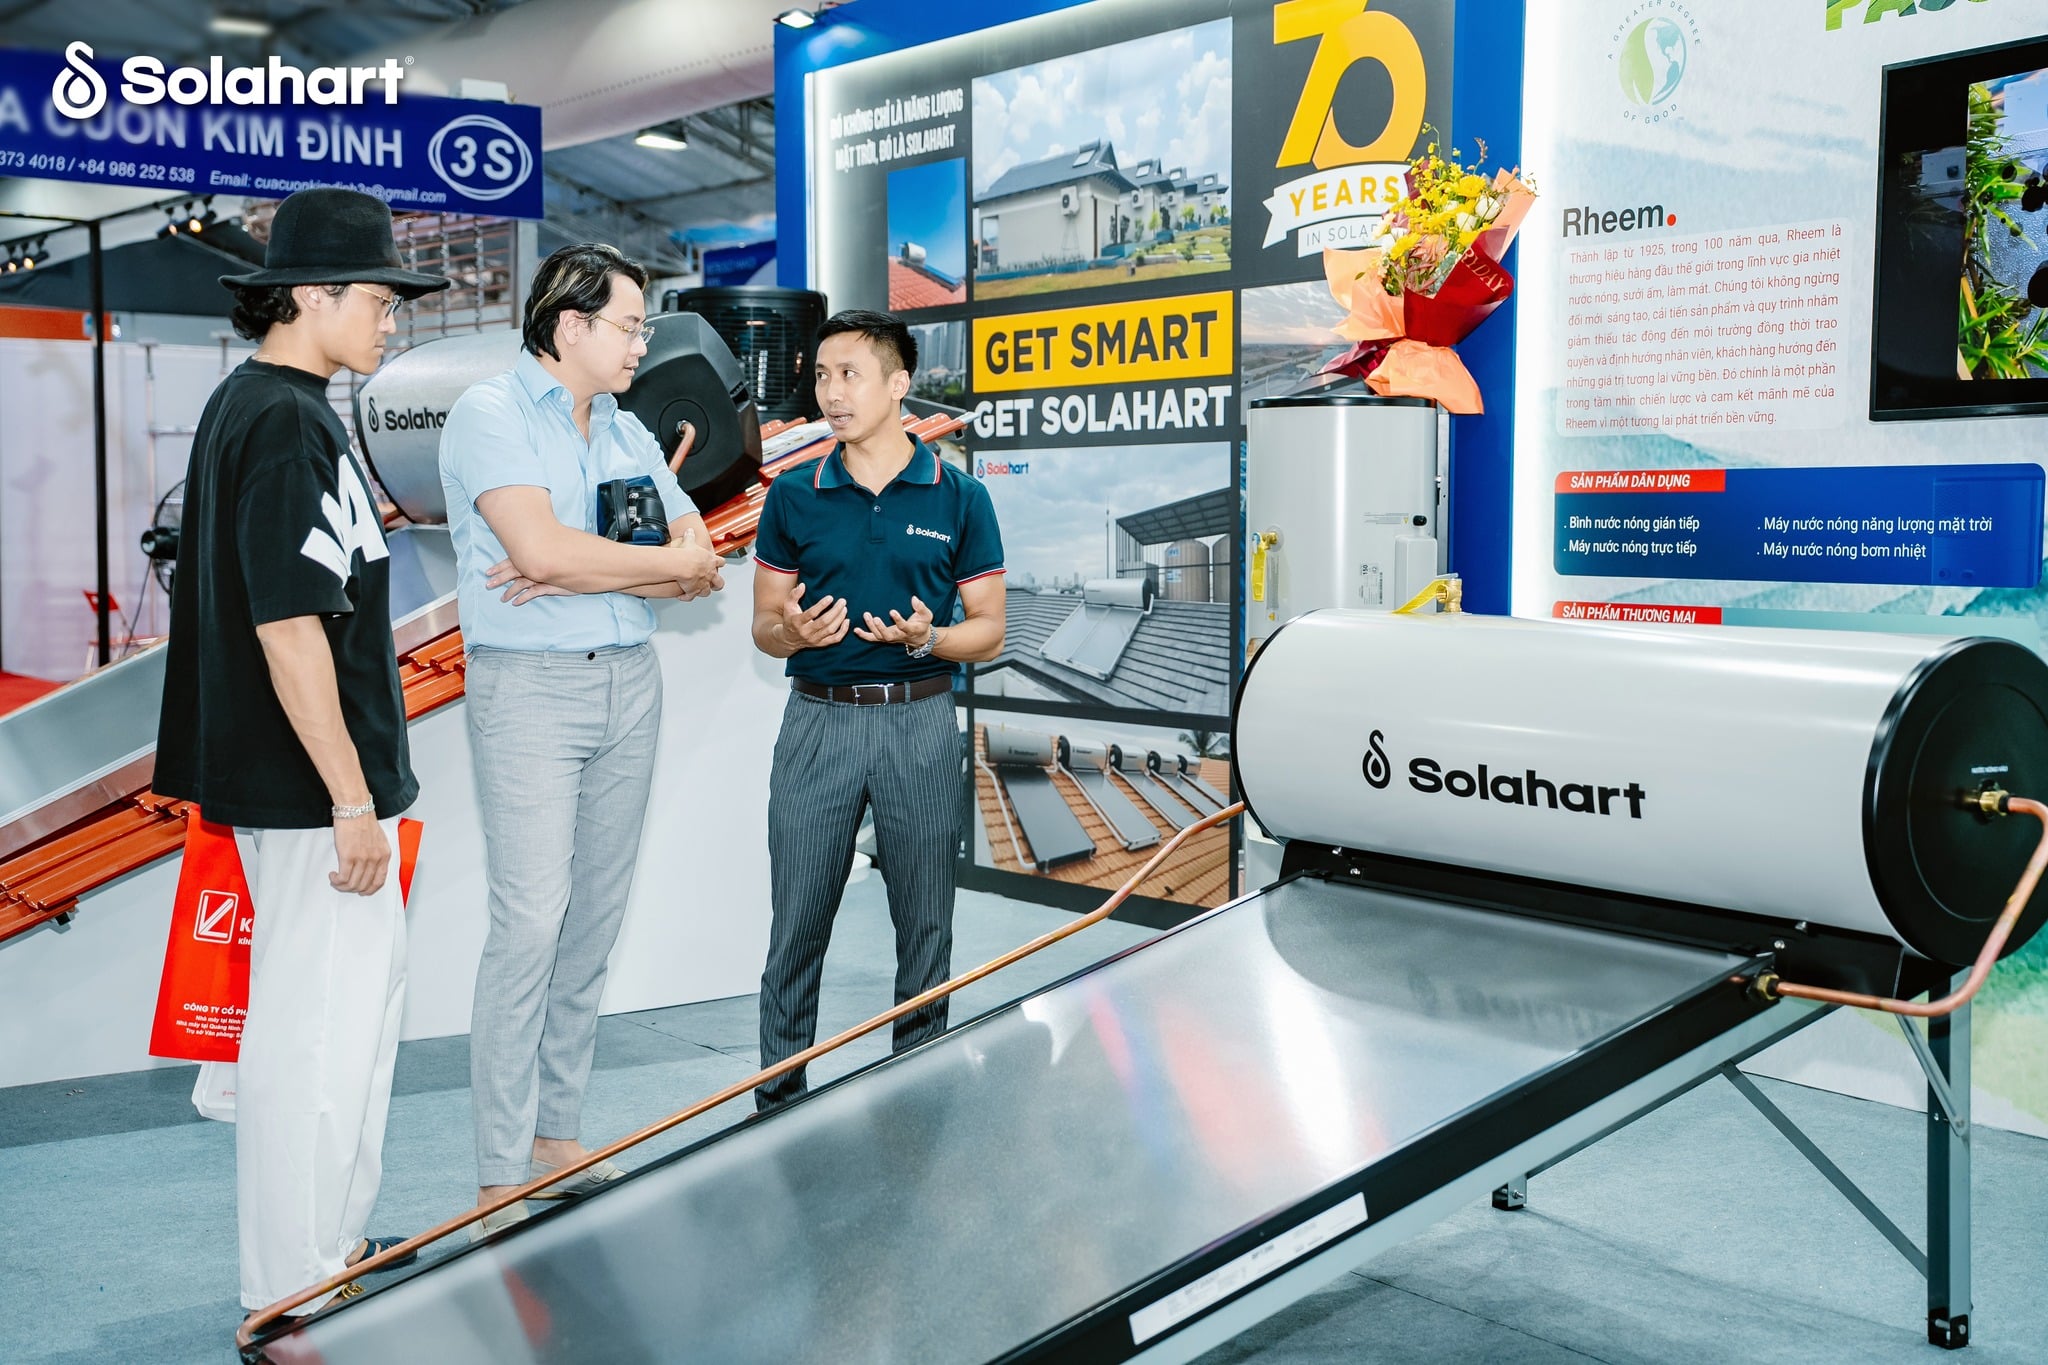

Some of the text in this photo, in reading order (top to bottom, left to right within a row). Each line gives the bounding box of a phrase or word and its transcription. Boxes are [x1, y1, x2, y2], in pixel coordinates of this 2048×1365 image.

[1274, 0, 1427, 170] 70
[1645, 104, 1677, 124] GOOD
[202, 112, 284, 158] KIM
[906, 124, 956, 156] SOLAHART
[29, 154, 66, 172] 4018
[78, 159, 104, 175] +84
[108, 161, 136, 178] 986
[139, 164, 165, 180] 252
[168, 166, 195, 183] 538
[210, 170, 251, 188] Email:
[1289, 176, 1400, 216] YEARS
[1307, 231, 1320, 246] IN
[1640, 244, 1666, 256] 1925,
[1672, 242, 1697, 253] trong
[1704, 237, 1722, 250] 100
[1758, 233, 1780, 246] qua,
[1788, 228, 1824, 240] Rheem
[1832, 224, 1841, 236] là
[1628, 267, 1651, 280] hàng
[1717, 260, 1744, 272] trong
[1770, 255, 1789, 267] vực
[1793, 251, 1808, 266] gia
[1813, 248, 1840, 262] nhiệt
[1667, 285, 1685, 296] làm
[1714, 280, 1747, 293] Chúng
[1751, 276, 1764, 289] tôi
[1768, 275, 1800, 288] không
[1804, 272, 1839, 287] ngừng
[1608, 311, 1630, 324] sáng
[1744, 300, 1754, 312] và
[1758, 300, 1776, 314] quy
[1780, 296, 1803, 309] trình
[985, 310, 1218, 375] GET SMART
[1622, 332, 1636, 343] tác
[1694, 326, 1712, 337] môi
[1718, 324, 1752, 337] trường
[1758, 320, 1784, 334] đồng
[1790, 318, 1810, 331] thời
[1816, 319, 1838, 330] trao
[1596, 354, 1606, 365] và
[1610, 352, 1629, 366] định
[1664, 349, 1688, 360] nhân
[1716, 346, 1746, 357] khách
[1750, 344, 1775, 357] hàng
[1778, 342, 1812, 355] hướng
[1816, 338, 1836, 352] đến
[1598, 376, 1612, 389] giá
[1627, 374, 1654, 386] tương
[1658, 372, 1668, 383] lai
[1723, 368, 1736, 379] Đó
[1740, 366, 1768, 378] chính
[1772, 365, 1780, 376] là
[1784, 364, 1805, 378] một
[1808, 362, 1835, 377] phần
[1567, 398, 1590, 410] trong
[1640, 392, 1665, 405] chiến
[1696, 392, 1706, 402] và
[1711, 392, 1732, 402] cam
[1738, 388, 1754, 400] kết
[1814, 385, 1834, 397] của
[385, 407, 450, 431] Solaha
[973, 385, 1232, 439] GET SOLAHART
[1566, 418, 1597, 428] Rheem
[1632, 416, 1658, 428] tương
[1662, 415, 1672, 426] lai
[1676, 414, 1698, 426] phát
[1726, 410, 1744, 424] bền
[986, 461, 1029, 475] Solahart
[1571, 472, 1690, 490] SẢN PHẨM DÂN DỤNG
[915, 528, 951, 543] Solahart
[1570, 514, 1700, 532] Bình nước nóng gián tiếp
[1764, 517, 1992, 535] Máy nước nóng năng lượng mặt trời
[1570, 540, 1697, 557] Máy nước nóng trực tiếp
[1764, 542, 1926, 560] Máy nước nóng bơm nhiệt
[1562, 603, 1584, 618] SẢN
[1587, 604, 1620, 620] PHẨM
[1622, 606, 1670, 622] THƯƠNG
[1408, 757, 1646, 819] Solahart
[184, 1002, 208, 1012] CÔNG
[210, 1006, 220, 1014] TY
